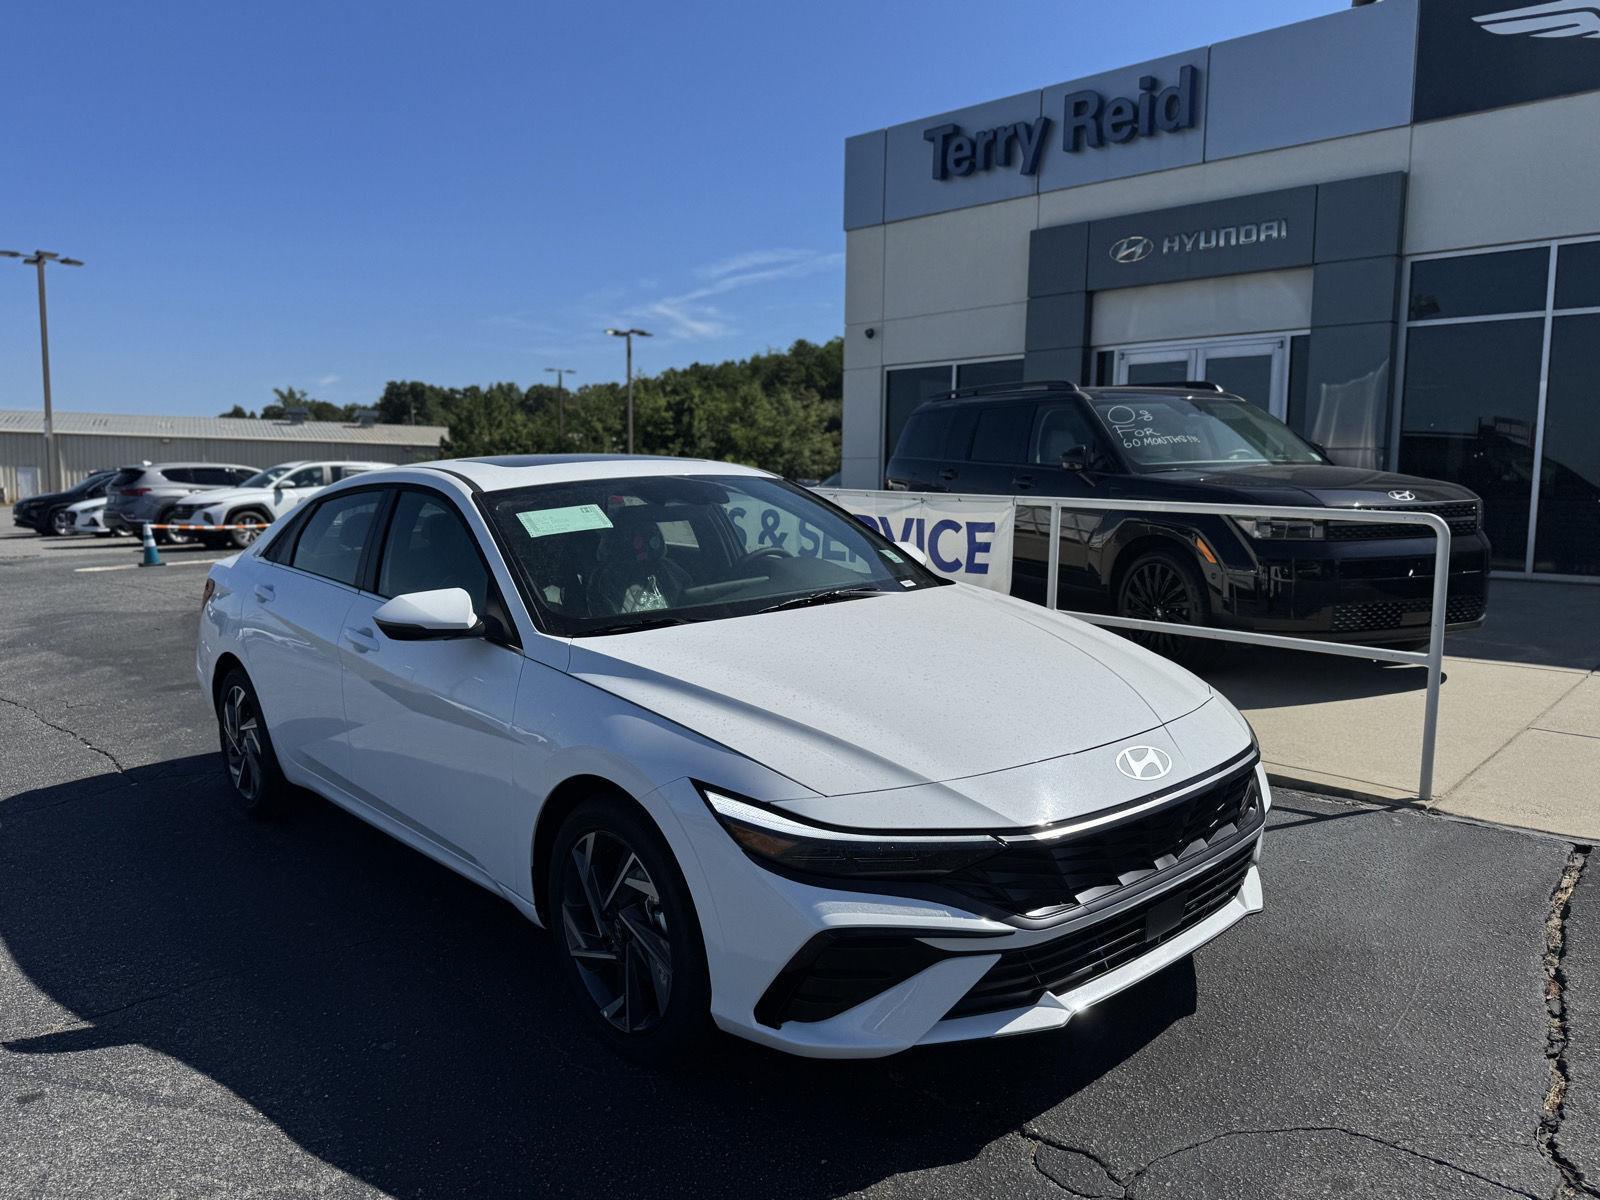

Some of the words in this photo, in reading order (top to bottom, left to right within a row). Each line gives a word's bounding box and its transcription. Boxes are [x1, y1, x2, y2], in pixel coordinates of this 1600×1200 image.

[923, 116, 1051, 181] Terry
[1062, 64, 1199, 152] Reid
[1162, 220, 1288, 255] HYUNDAI
[1112, 423, 1161, 438] FOR
[1123, 438, 1141, 448] 60
